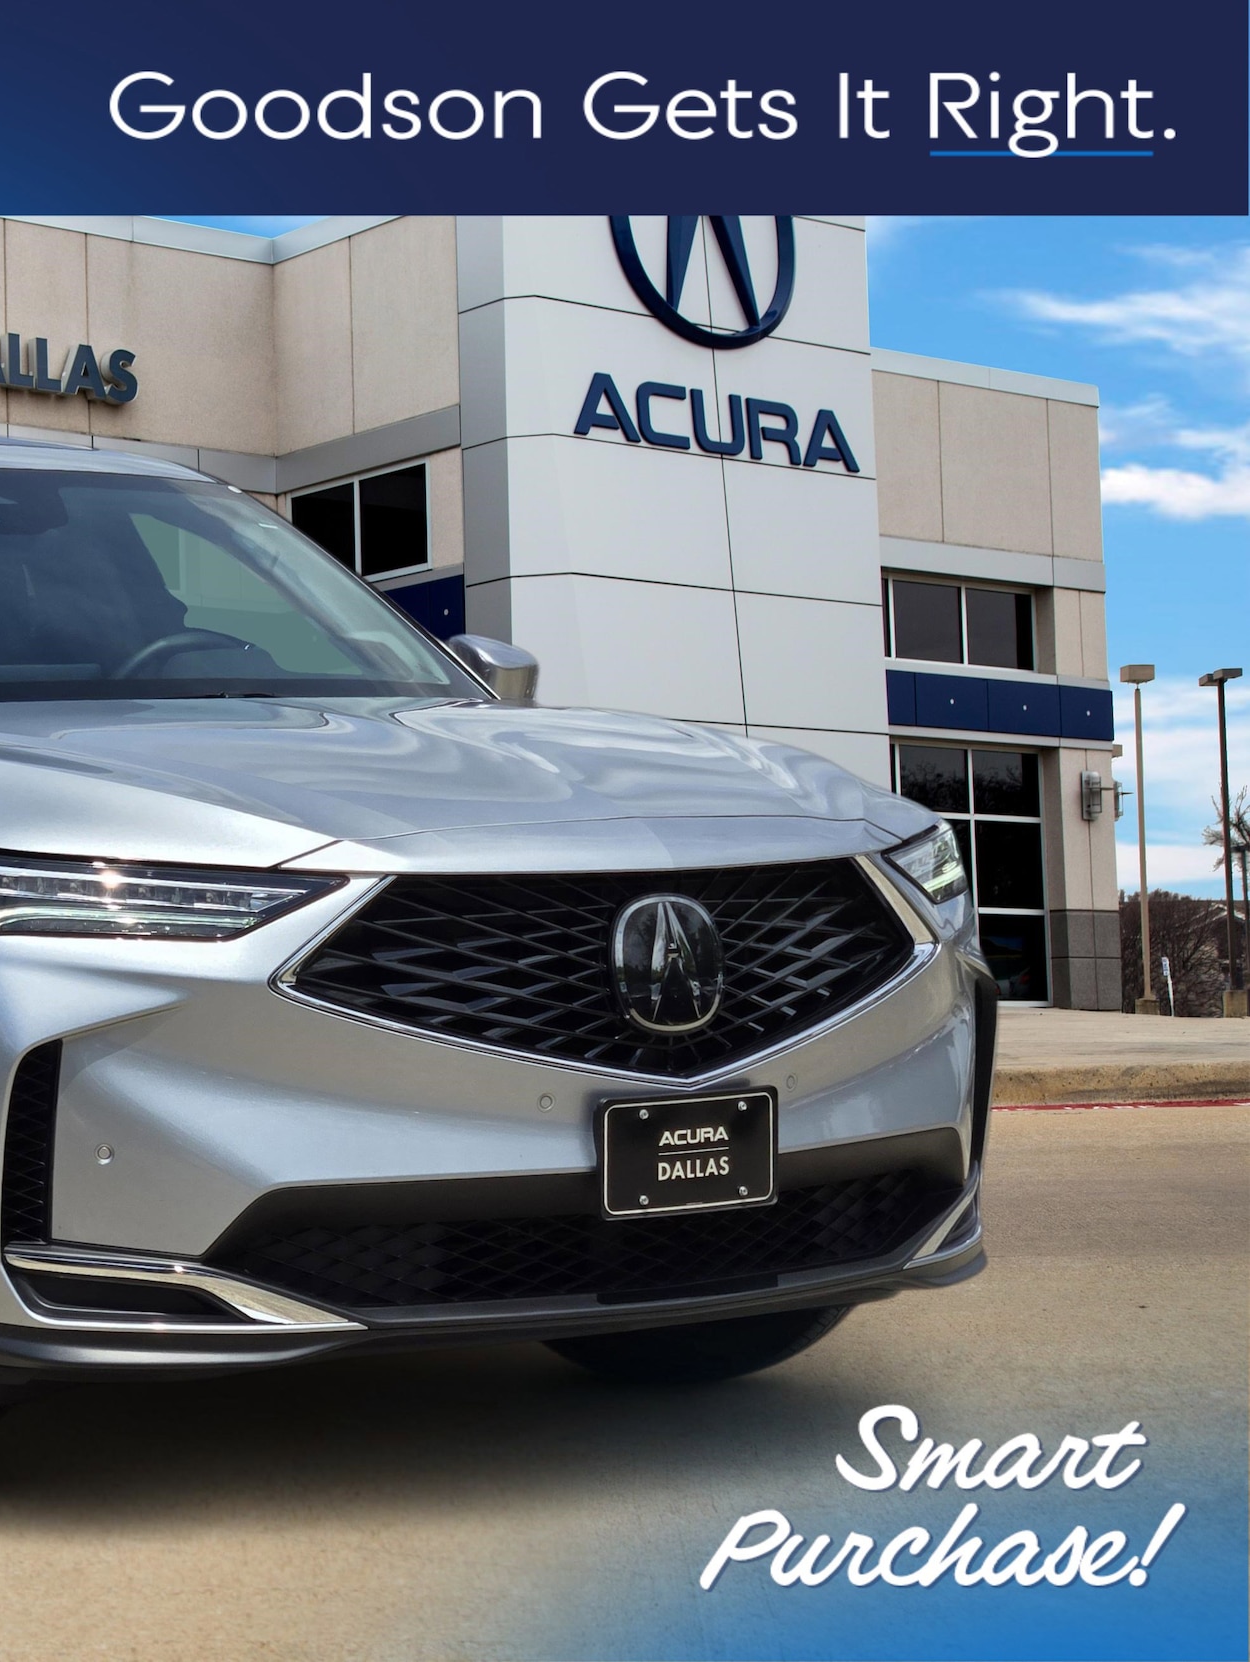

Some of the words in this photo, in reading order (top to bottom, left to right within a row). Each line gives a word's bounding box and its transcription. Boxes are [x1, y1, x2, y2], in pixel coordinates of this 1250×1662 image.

[573, 371, 861, 474] ACURA
[658, 1126, 730, 1147] ACURA
[657, 1156, 731, 1181] DALLAS
